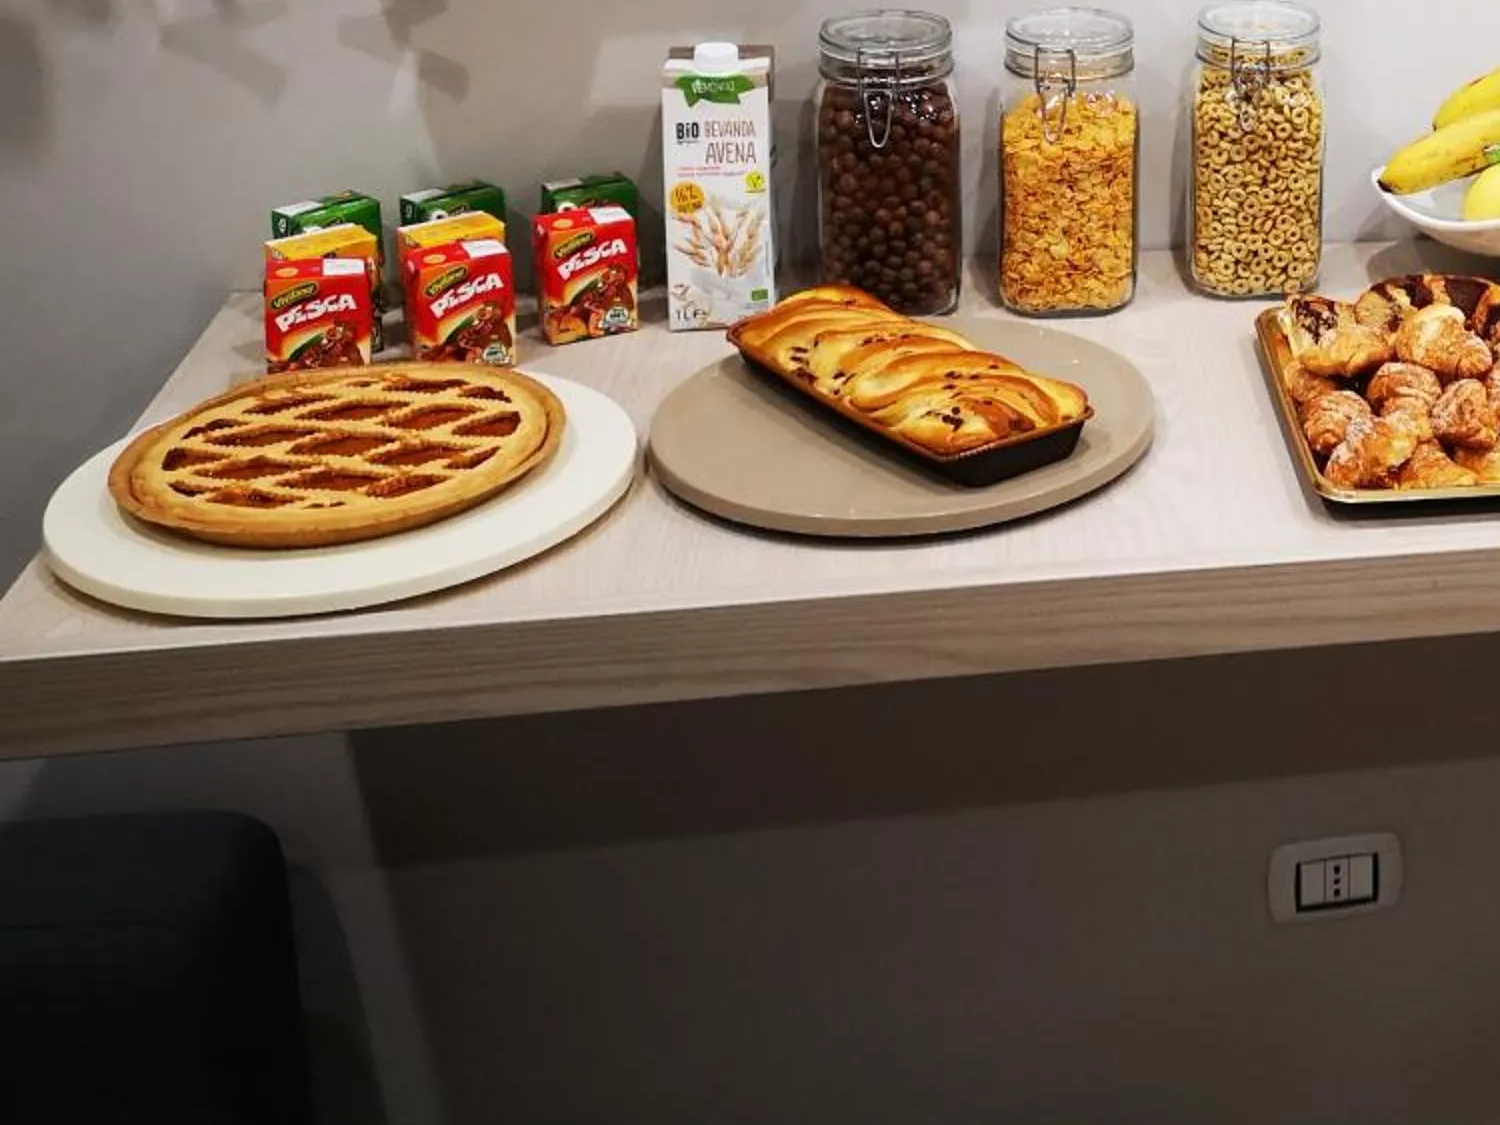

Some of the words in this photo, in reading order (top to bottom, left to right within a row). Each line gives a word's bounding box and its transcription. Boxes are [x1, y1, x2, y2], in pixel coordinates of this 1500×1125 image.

[703, 120, 756, 138] BEVANDA
[706, 141, 757, 164] AVENA
[557, 238, 629, 281] PESCA
[274, 294, 358, 333] PESCA
[430, 272, 504, 319] PESCA
